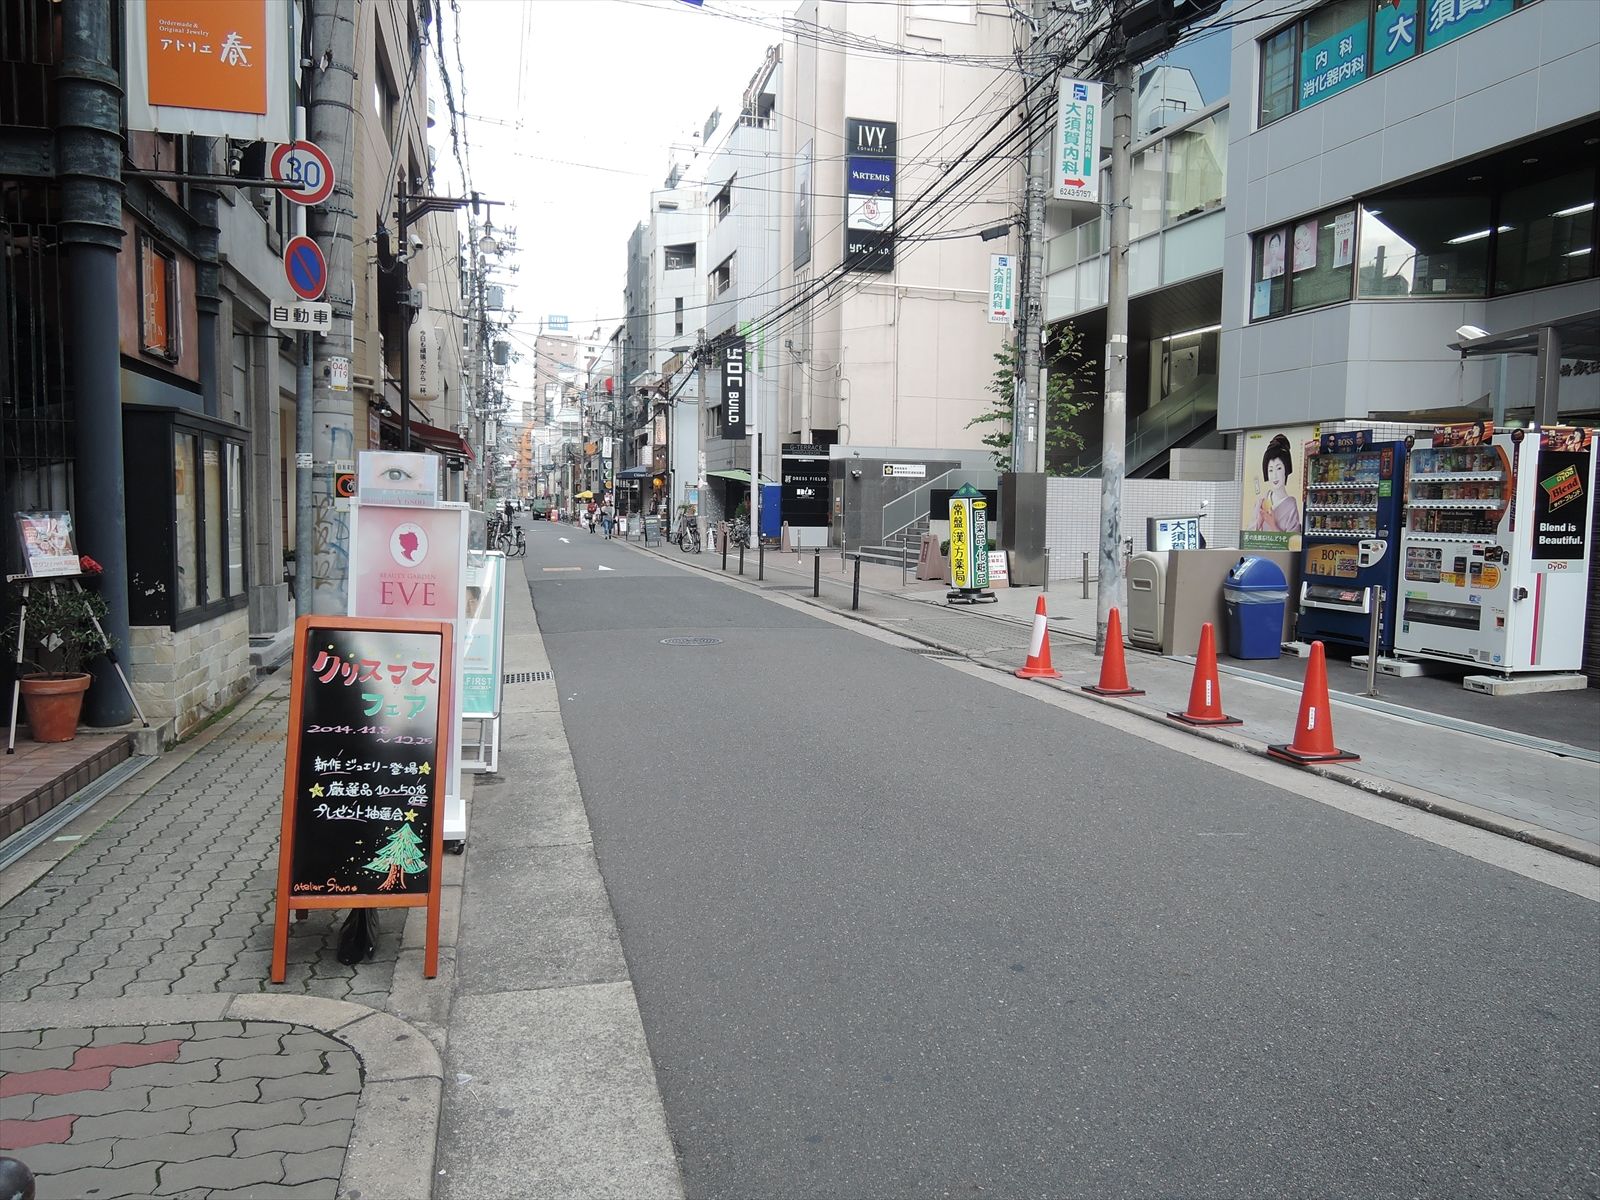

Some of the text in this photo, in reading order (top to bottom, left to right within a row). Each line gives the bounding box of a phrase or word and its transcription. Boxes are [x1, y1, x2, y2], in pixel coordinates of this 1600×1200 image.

[159, 19, 193, 28] Ordermade
[159, 25, 185, 34] Original
[160, 31, 252, 66] アトリエ 春
[1315, 36, 1353, 70] 内科
[1302, 54, 1365, 99] 消化器内科
[1062, 102, 1082, 176] 大須賀内科
[286, 157, 320, 188] 30
[1060, 187, 1092, 199] 6243-5757
[273, 306, 329, 325] 自動車
[728, 391, 740, 426] BUILD.
[1556, 468, 1574, 482] DyDo
[1551, 477, 1579, 499] Blend
[1538, 535, 1583, 545] Beautiful.
[1539, 523, 1577, 532] Blend is
[953, 503, 966, 582] 常盤漢方薬局
[976, 511, 986, 585] 医薬品・化粧品
[1547, 563, 1568, 571] DyDo
[381, 581, 436, 606] EVE
[312, 651, 436, 686] クリスマス
[361, 693, 427, 719] フェア
